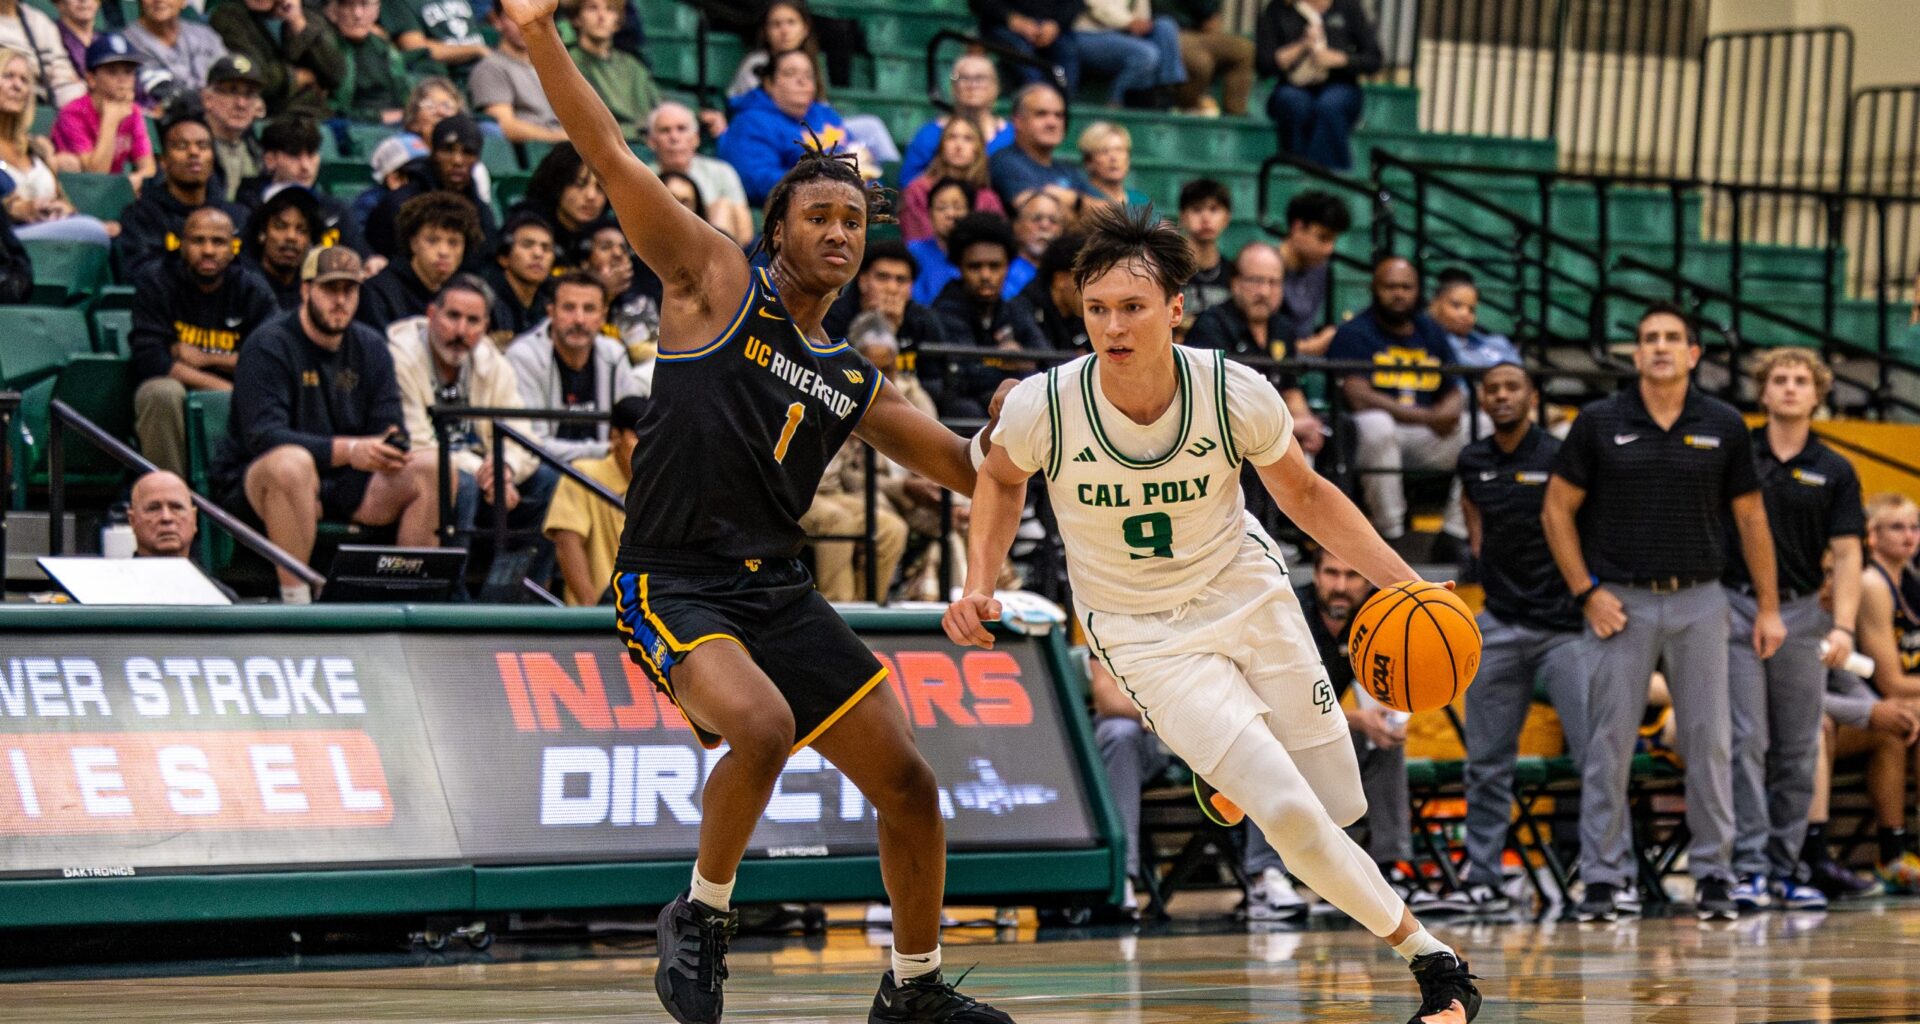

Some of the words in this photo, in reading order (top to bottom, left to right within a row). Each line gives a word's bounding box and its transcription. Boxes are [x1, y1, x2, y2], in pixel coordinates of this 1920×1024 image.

[744, 336, 771, 367] UC
[774, 402, 806, 465] 1
[1077, 483, 1130, 507] CAL
[1142, 474, 1210, 505] POLY
[1122, 512, 1173, 560] 9
[124, 656, 367, 716] STROKE
[496, 651, 1035, 732] INJRS
[1373, 653, 1391, 706] NCAA
[9, 744, 385, 818] IESEL
[541, 745, 864, 825] DIRCT
[64, 867, 136, 878] DAKTRONICS
